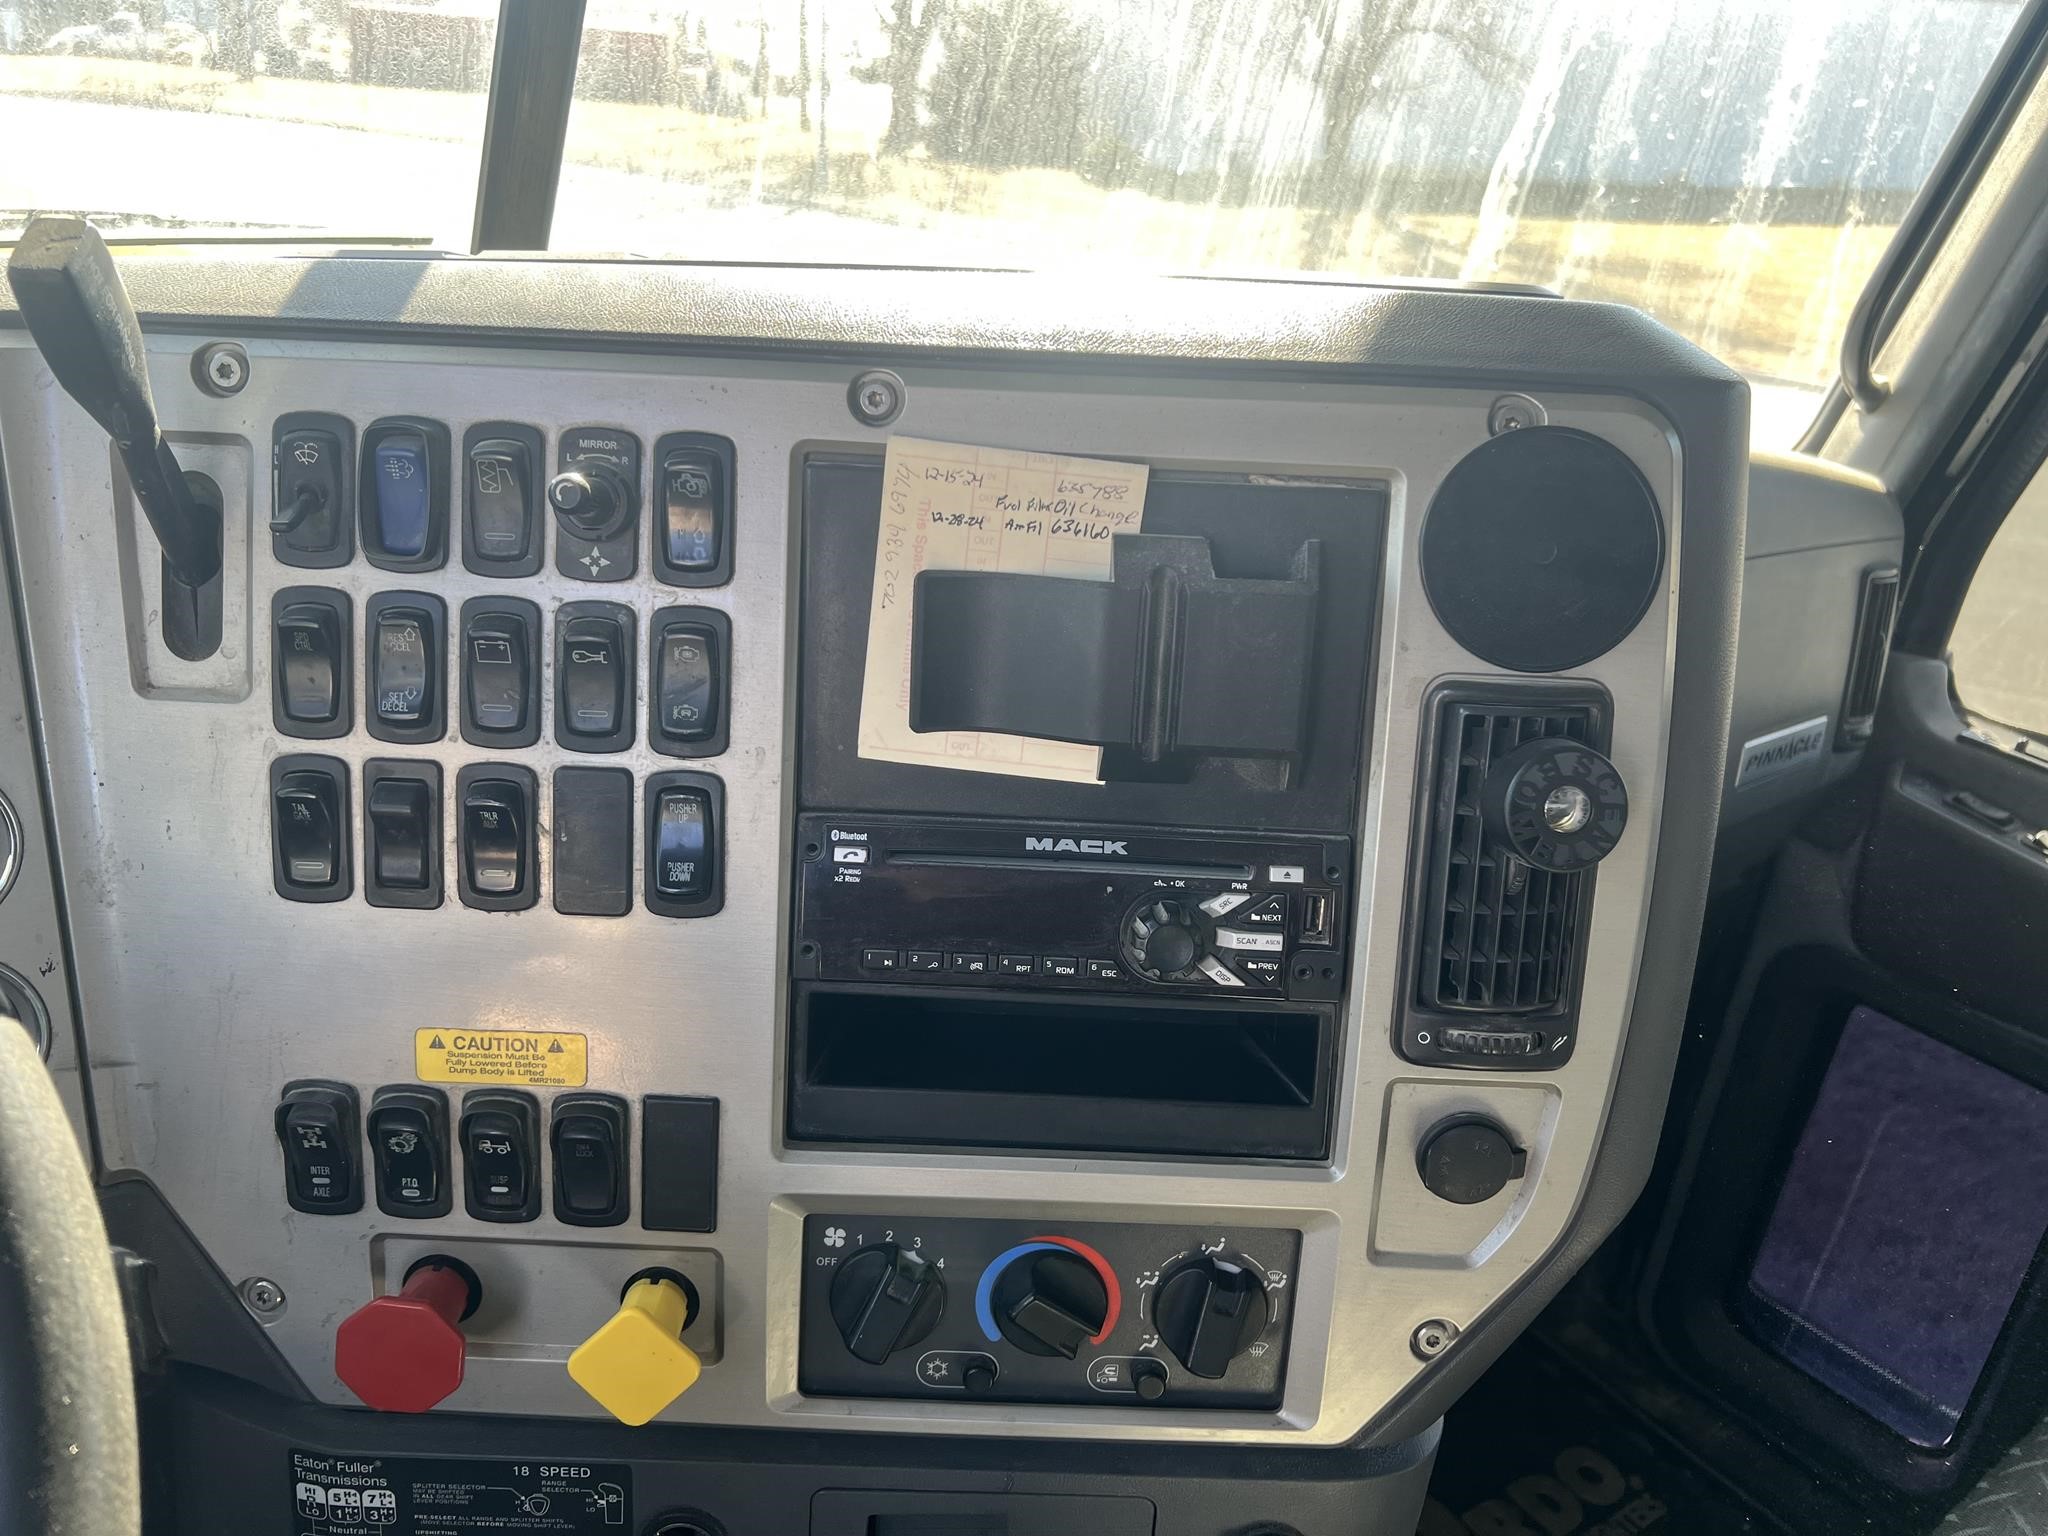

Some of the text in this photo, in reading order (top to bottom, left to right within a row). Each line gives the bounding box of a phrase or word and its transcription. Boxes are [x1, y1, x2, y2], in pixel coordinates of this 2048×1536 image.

[579, 439, 617, 450] MIRROR
[566, 453, 573, 462] L
[621, 456, 629, 465] R
[911, 499, 932, 576] This Spac
[389, 692, 404, 702] SET
[382, 702, 408, 712] DECEL
[1745, 732, 1823, 772] PINNACLE
[669, 803, 697, 814] PUSHER
[480, 812, 498, 820] TRLR
[678, 813, 689, 823] UP
[1026, 837, 1128, 855] MACK
[667, 861, 695, 872] PUSHER
[669, 871, 691, 882] DOWN
[1175, 880, 1185, 888] OK
[1231, 882, 1248, 890] PWR
[1219, 897, 1233, 910] SRC
[1262, 914, 1281, 922] NEXT
[1236, 937, 1257, 945] SCAN
[1015, 965, 1031, 973] RPT
[1056, 966, 1074, 974] RDM
[1258, 962, 1279, 971] PREV
[1215, 970, 1231, 983] DISP
[453, 1036, 538, 1053] CAUTION
[447, 1051, 546, 1062] Suspension Must Be
[445, 1059, 548, 1069] Fully Lowered Before
[449, 1067, 477, 1076] Dump
[480, 1068, 505, 1077] Body
[517, 1069, 544, 1077] Lifted
[310, 1166, 330, 1175] INTER
[313, 1187, 330, 1197] AXLE
[857, 1234, 863, 1245] 1
[885, 1231, 893, 1242] 2
[913, 1237, 921, 1249] 3
[816, 1256, 838, 1266] OFF
[936, 1258, 945, 1269] 4
[513, 1465, 591, 1478] 18 SPEED
[294, 1467, 387, 1487] Transmissions
[304, 1487, 316, 1495] HI
[333, 1493, 341, 1502] 5
[367, 1494, 376, 1504] 7
[306, 1507, 319, 1516] LO
[336, 1509, 342, 1519] 1
[370, 1510, 378, 1520] 3
[329, 1525, 367, 1535] Neutral
